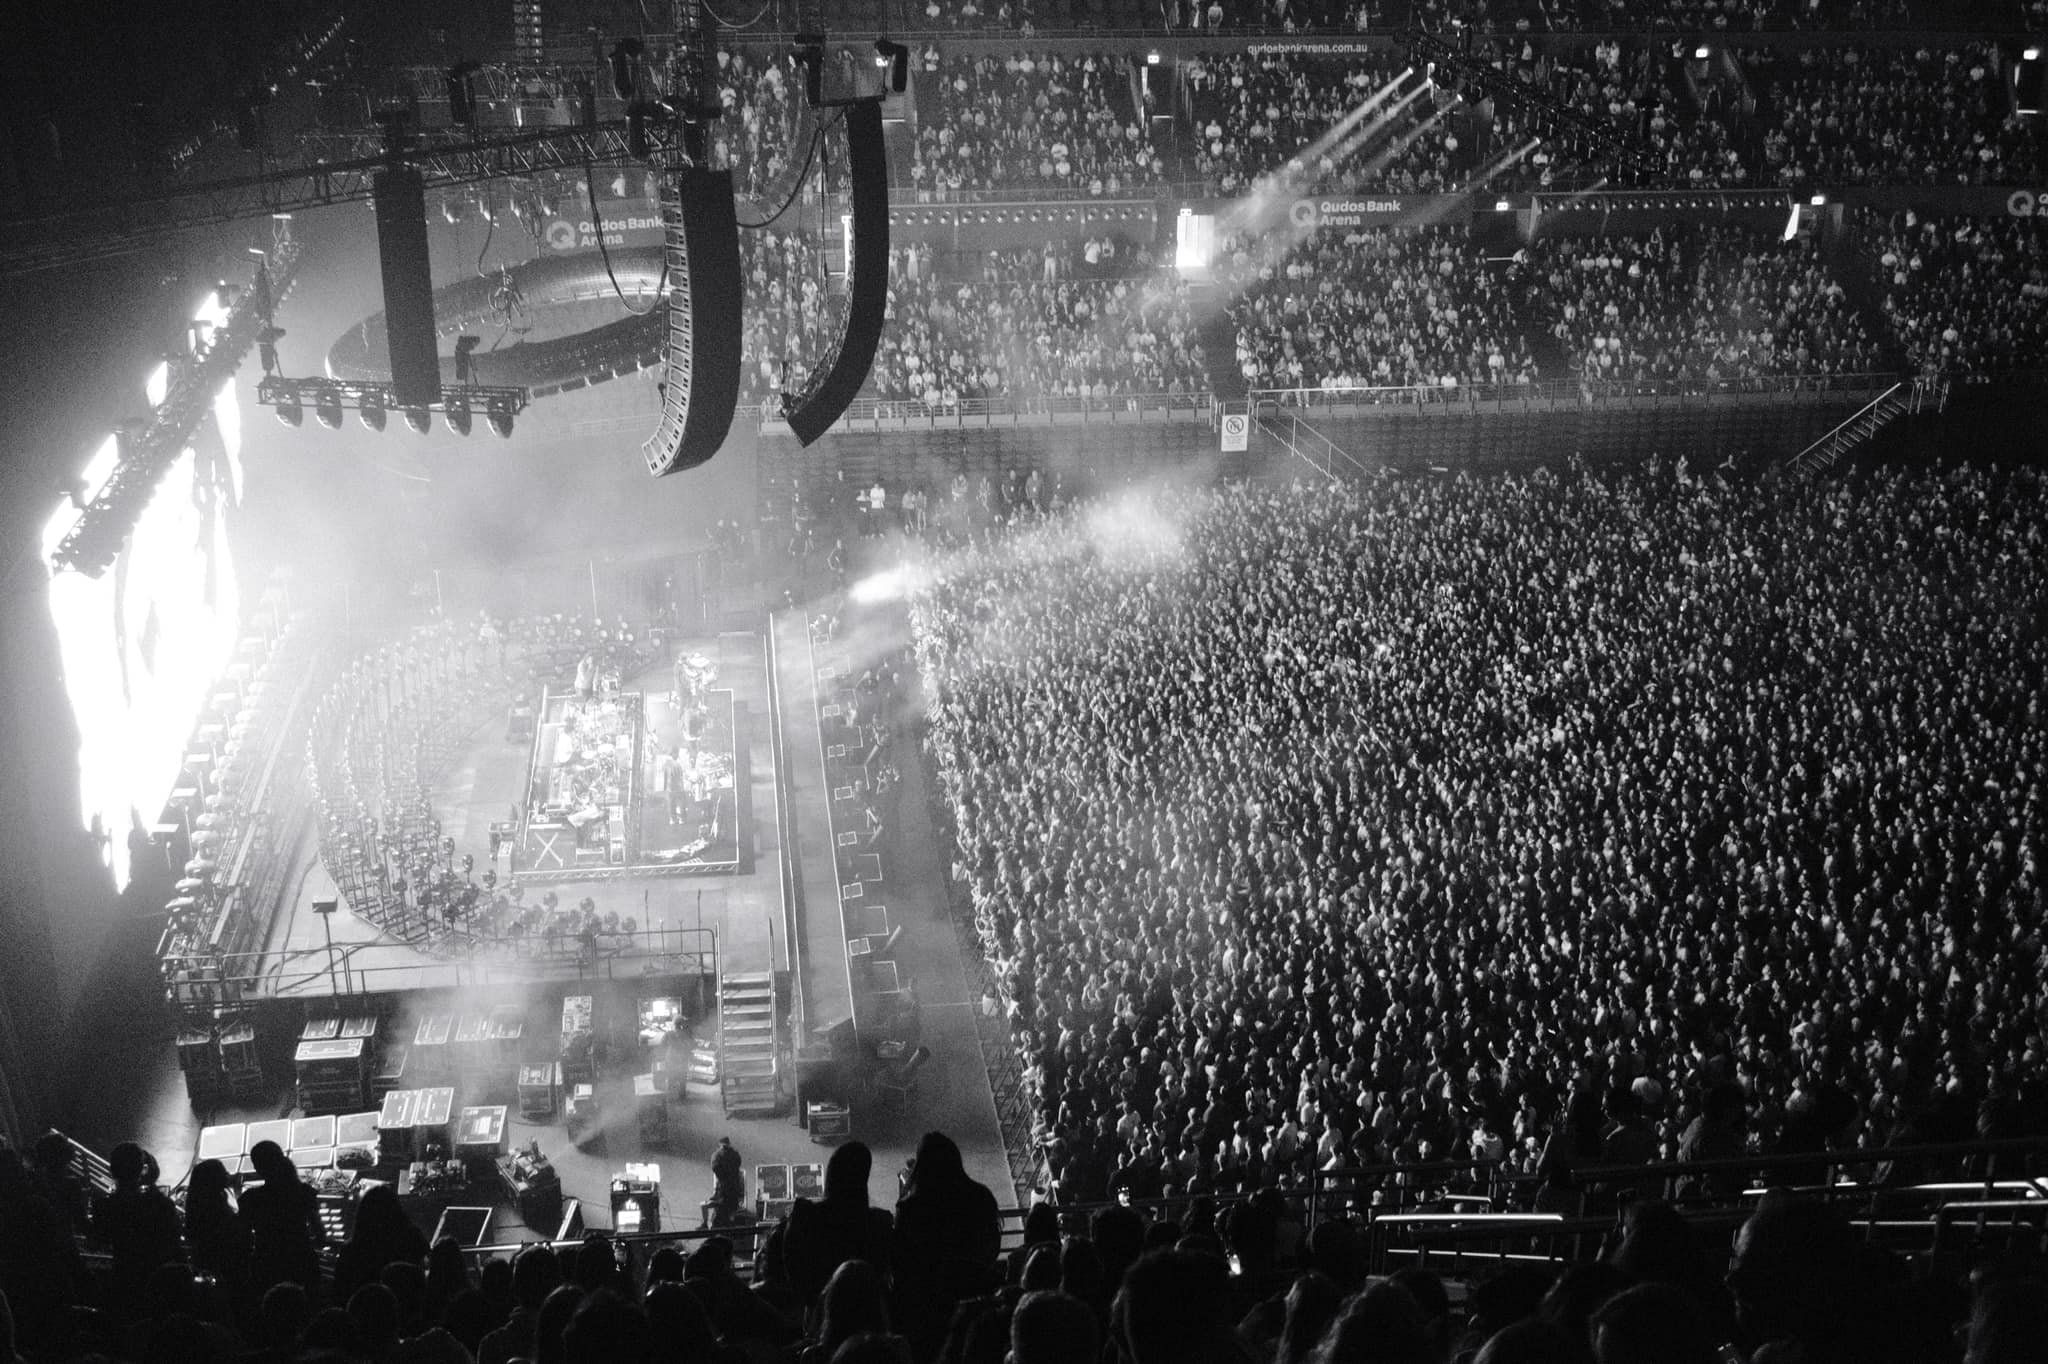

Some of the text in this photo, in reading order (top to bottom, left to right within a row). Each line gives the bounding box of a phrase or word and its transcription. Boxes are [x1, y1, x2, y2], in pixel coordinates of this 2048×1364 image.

[1320, 200, 1401, 213] Qudos Bank
[627, 215, 665, 229] Bank
[1320, 215, 1361, 226] Arena
[581, 234, 624, 247] Arna
